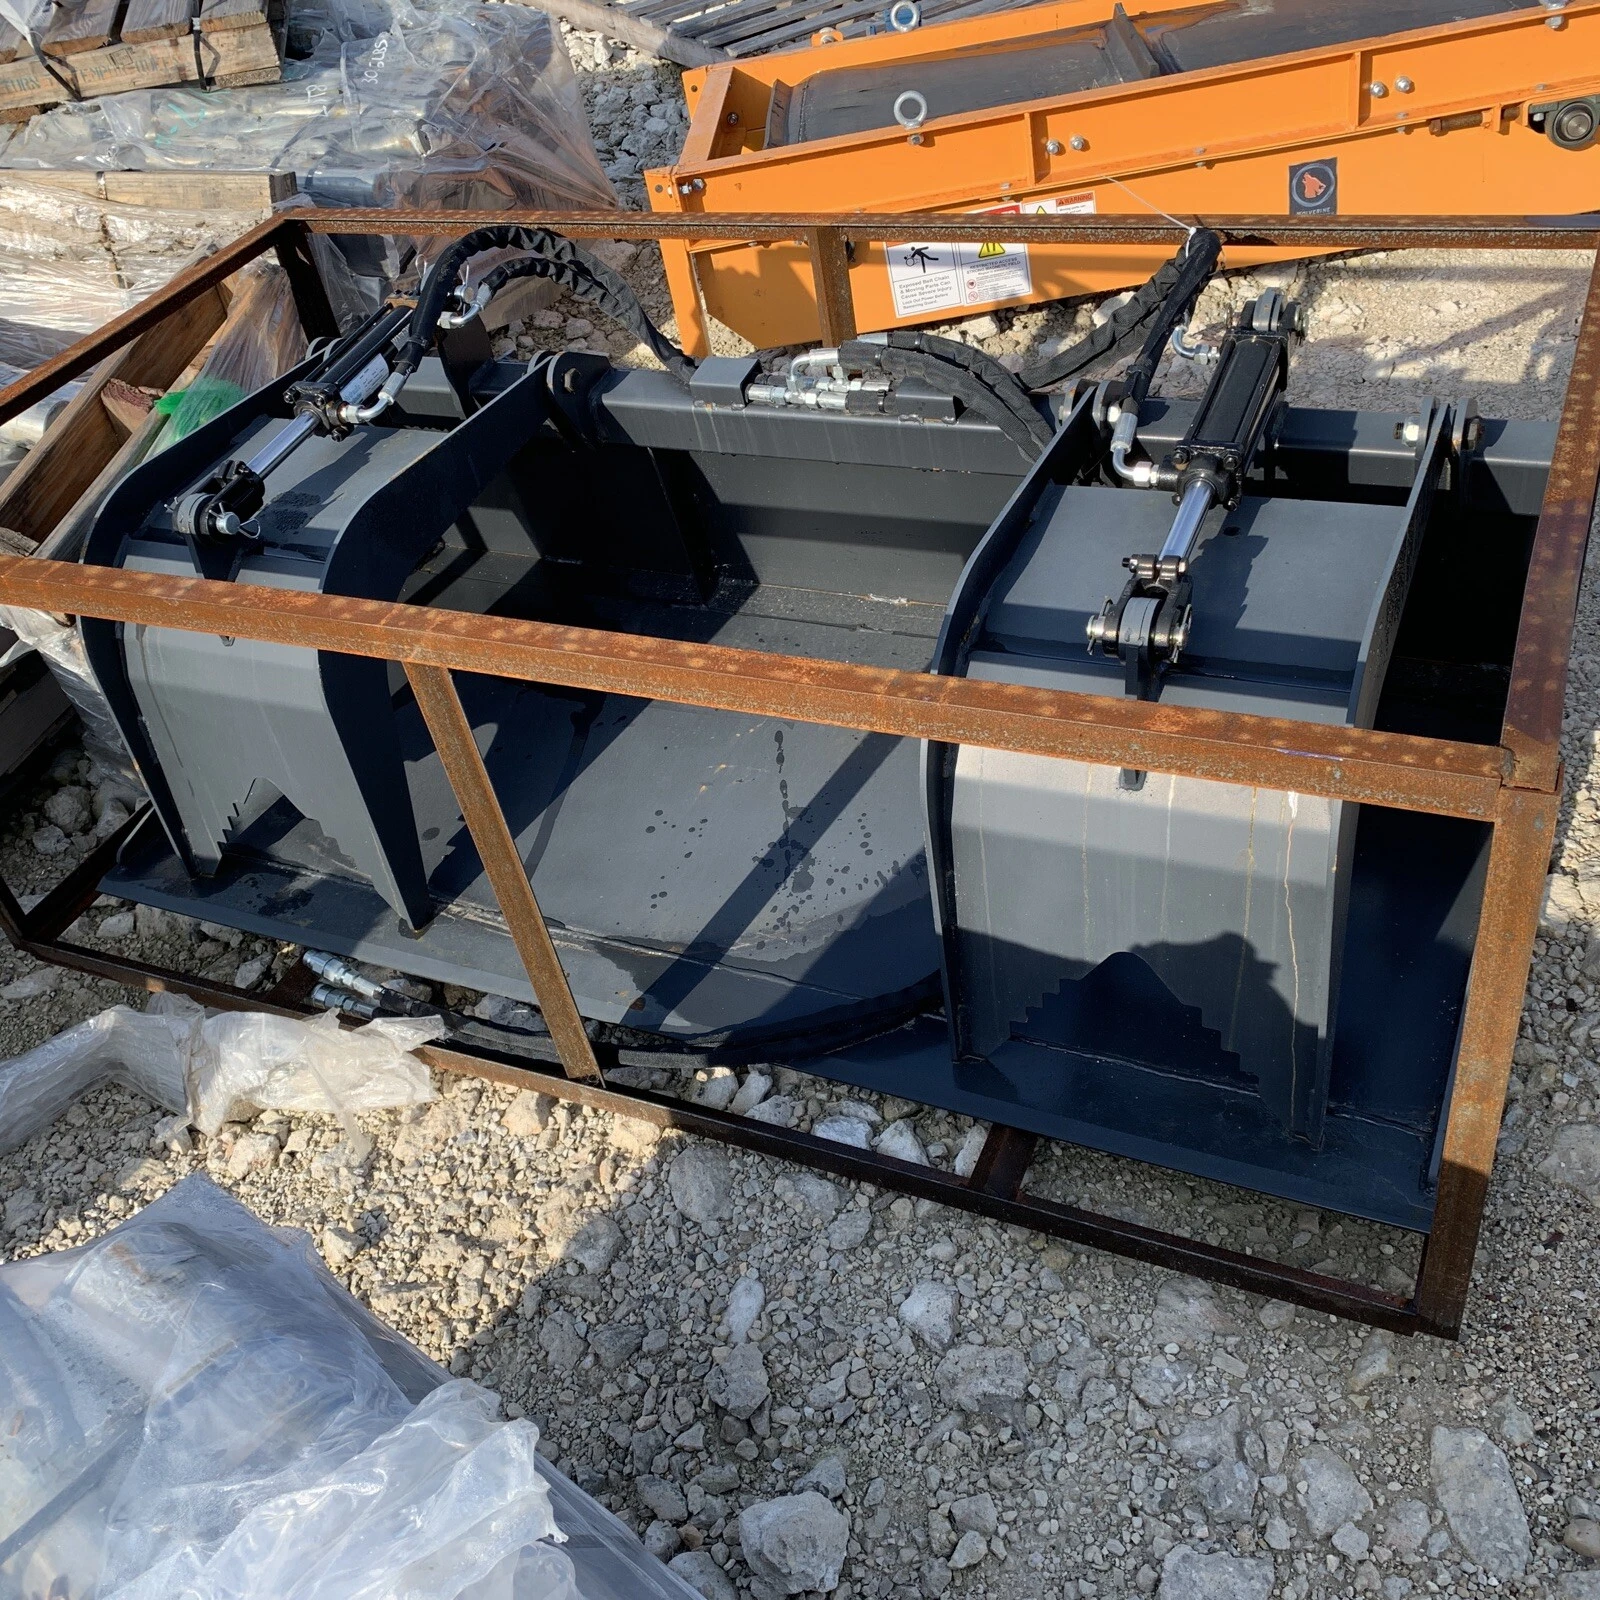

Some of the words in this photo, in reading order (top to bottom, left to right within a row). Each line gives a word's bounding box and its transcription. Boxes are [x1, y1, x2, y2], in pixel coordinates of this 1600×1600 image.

[1064, 193, 1093, 204] WARNING
[999, 256, 1018, 264] ACCESS
[899, 280, 922, 289] Exposed
[905, 285, 925, 294] Moving
[918, 288, 936, 296] Severe
